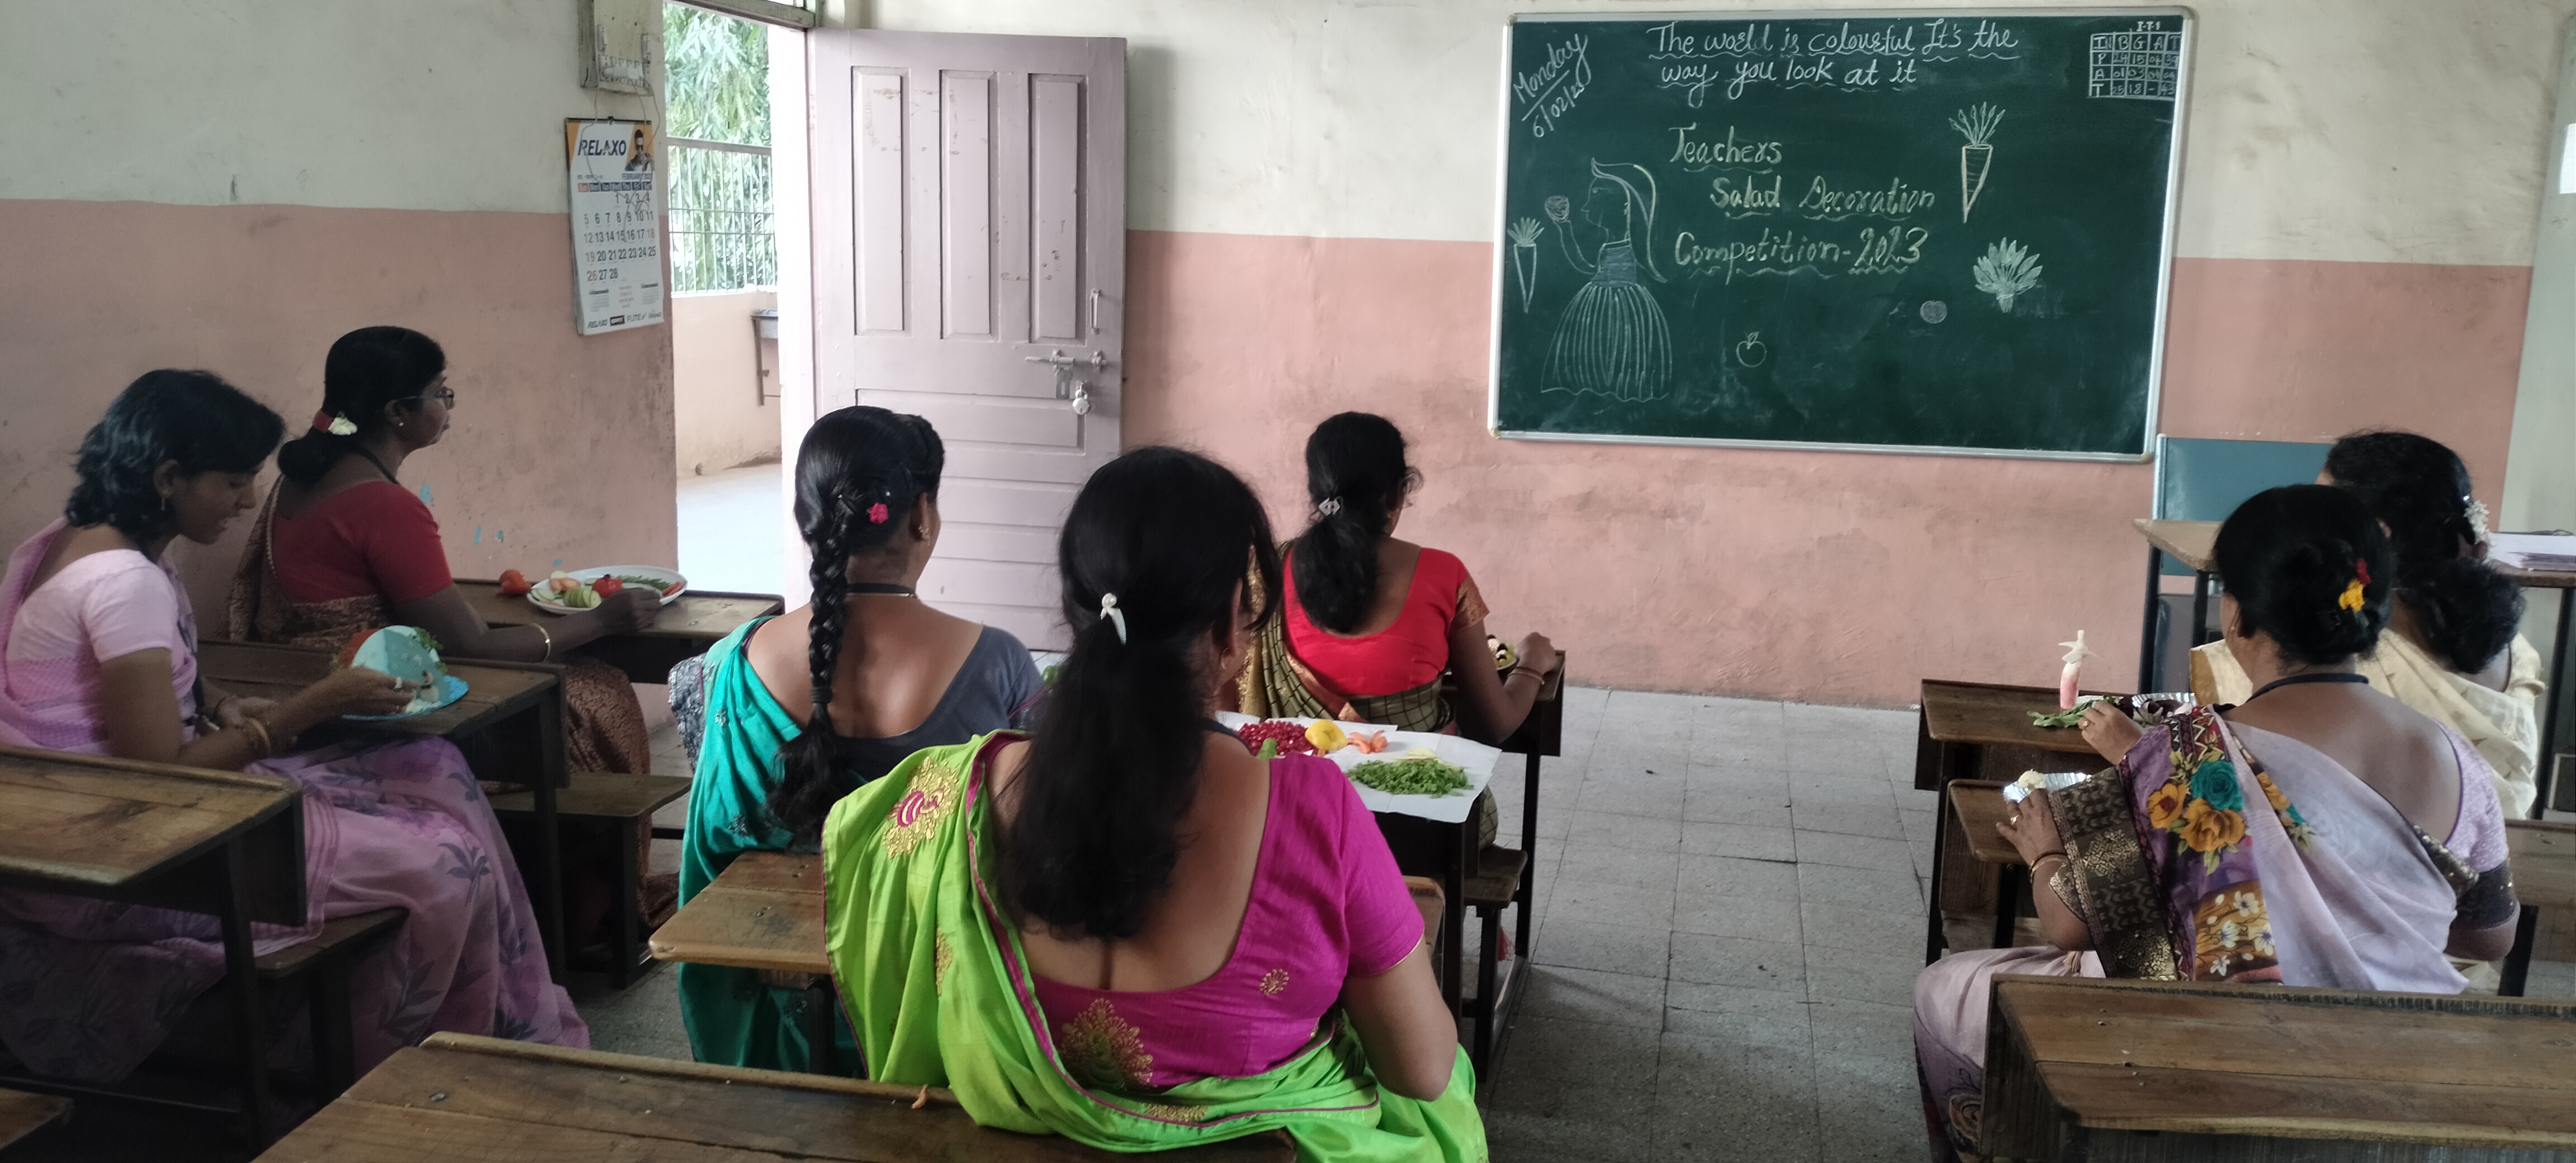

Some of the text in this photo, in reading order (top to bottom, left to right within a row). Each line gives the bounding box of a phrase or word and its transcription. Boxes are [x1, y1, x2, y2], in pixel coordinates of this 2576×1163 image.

[1646, 18, 2019, 55] The world is colourful It's the
[2118, 35, 2129, 50] B
[2133, 36, 2146, 50] G
[2153, 36, 2163, 50] A
[2170, 35, 2180, 50] T
[2098, 53, 2106, 65] P
[2133, 54, 2144, 64] 15
[1513, 34, 1592, 104] Monday
[2095, 69, 2104, 80] A
[2113, 68, 2124, 77] 01
[2128, 67, 2145, 79] 03
[1661, 56, 1917, 108] way you look at it
[2091, 84, 2104, 97] T
[2129, 83, 2142, 94] 18
[577, 139, 627, 156] RELAXO
[1668, 121, 1782, 164] Teachers
[615, 193, 619, 204] 1
[625, 193, 631, 204] 2
[646, 192, 650, 202] 4
[1710, 174, 1935, 214] Salad Decoration
[584, 210, 654, 225] 5 6 7 8 9 10 11
[584, 228, 655, 243] 12 13 14 15 16 17 18
[585, 246, 656, 262] 19 20 21 22 23 24 25
[586, 268, 618, 281] 26 27 28
